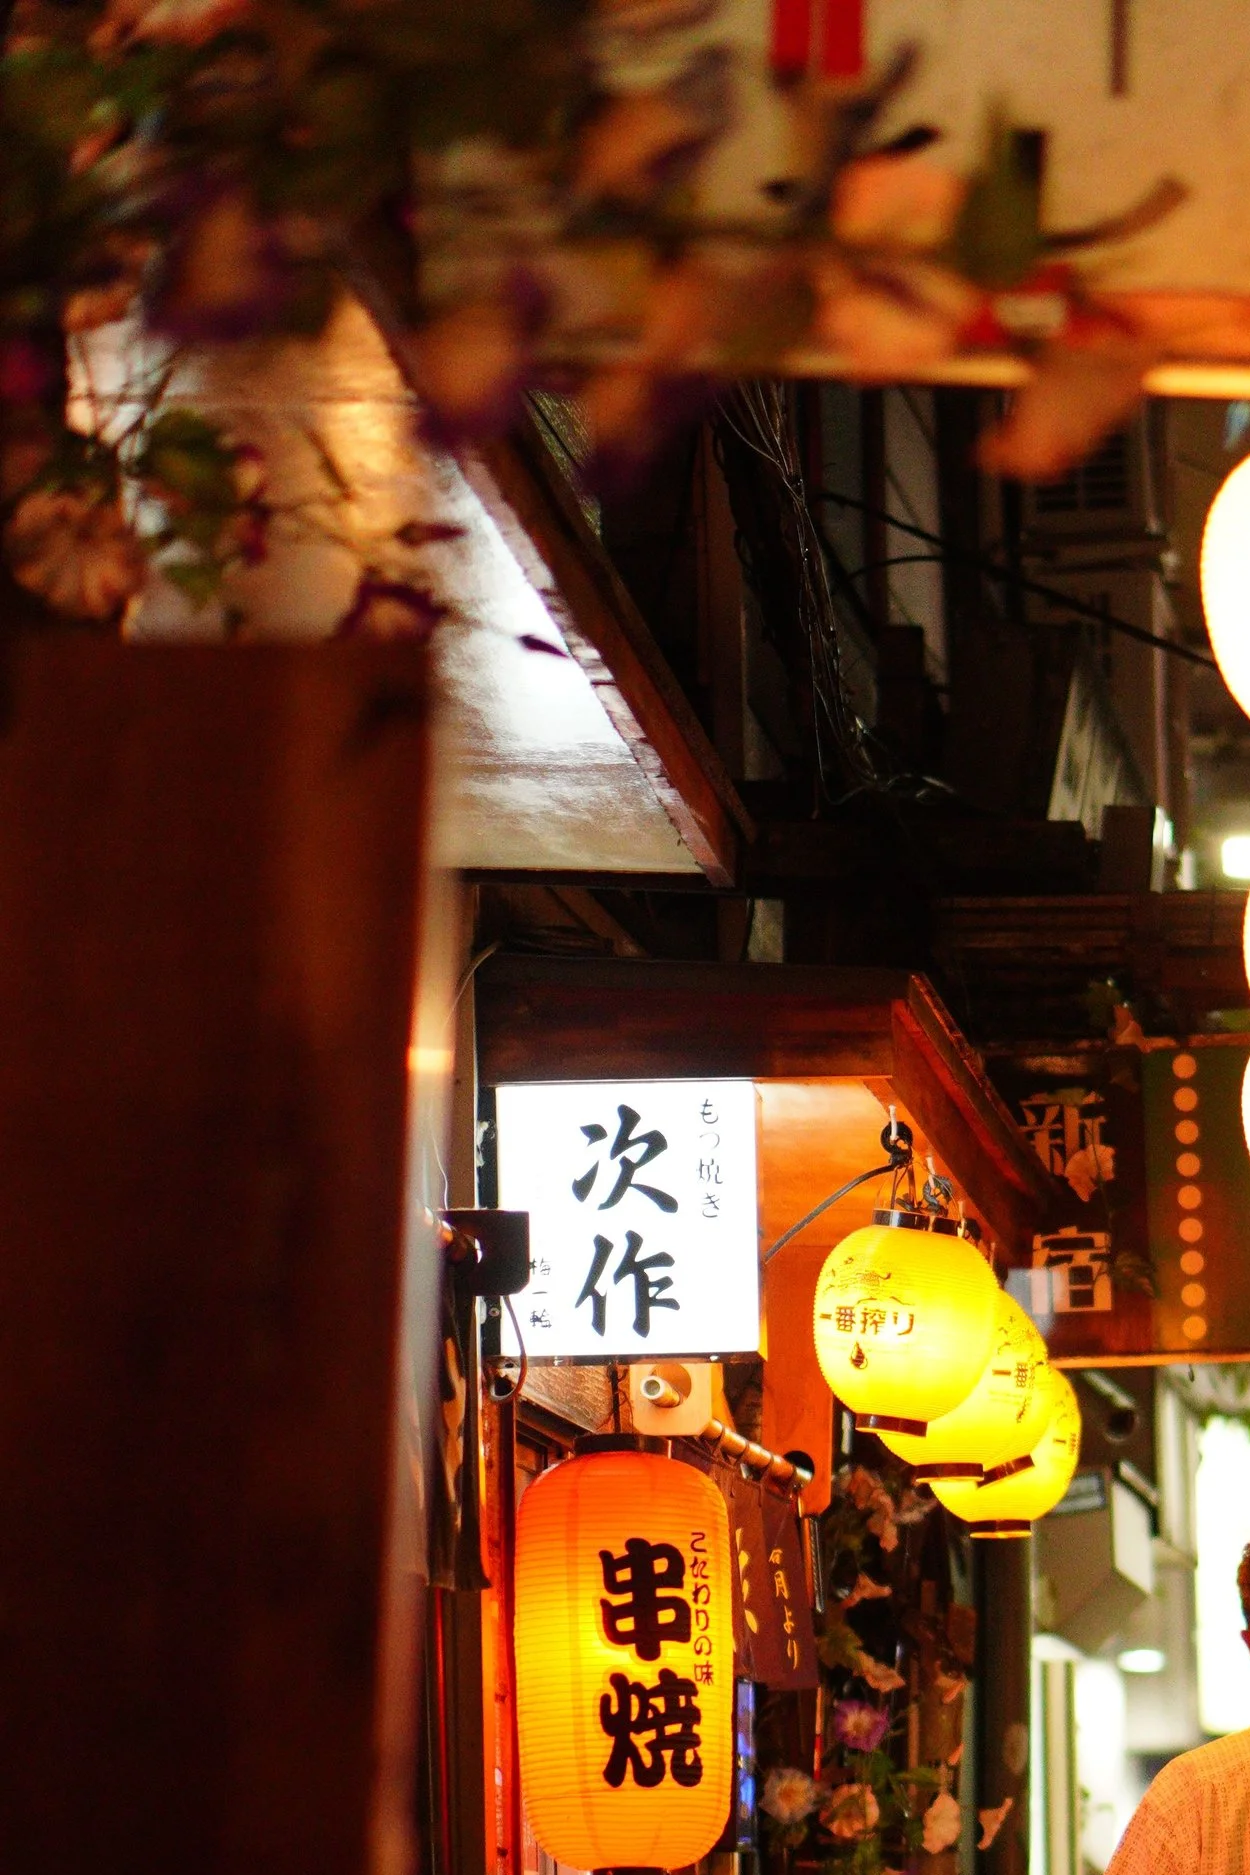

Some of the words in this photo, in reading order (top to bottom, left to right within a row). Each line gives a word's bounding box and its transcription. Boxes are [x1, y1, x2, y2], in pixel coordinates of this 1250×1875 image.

[571, 1104, 681, 1339] 次作
[819, 1305, 915, 1336] 一番搾り
[598, 1537, 704, 1788] 串焼
